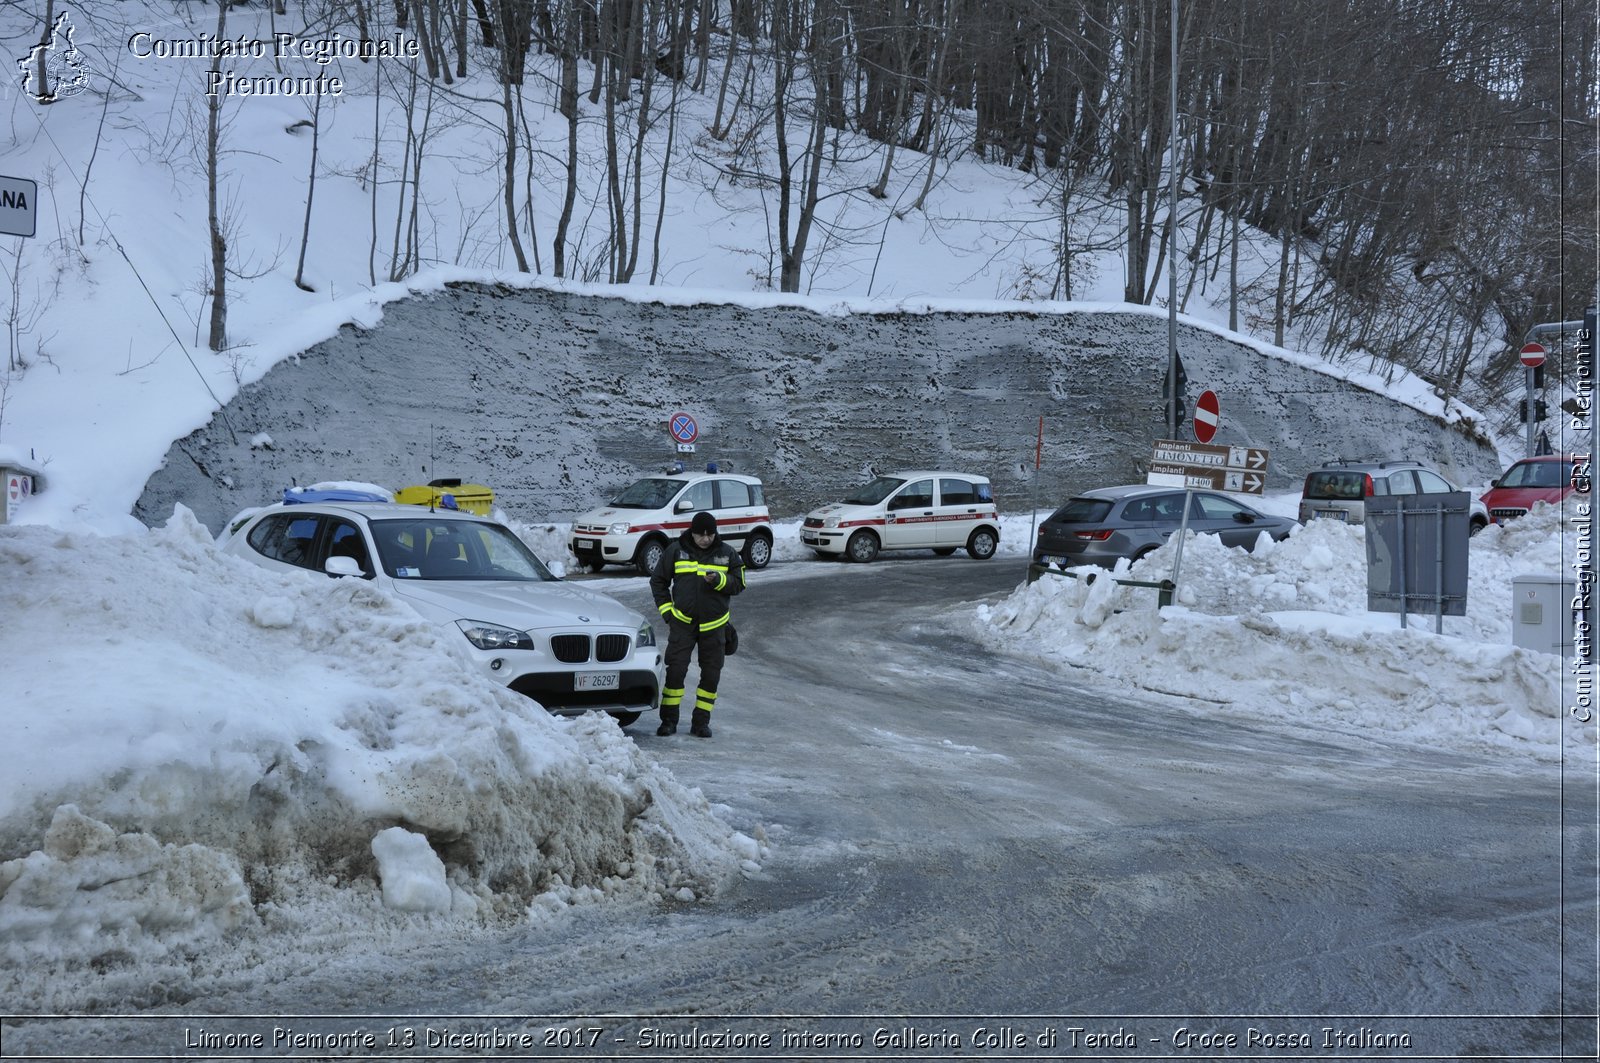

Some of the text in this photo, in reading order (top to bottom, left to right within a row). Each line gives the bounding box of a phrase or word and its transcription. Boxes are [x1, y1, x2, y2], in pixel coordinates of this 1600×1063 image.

[0, 189, 28, 210] NA
[1155, 450, 1224, 465] LIMONETTO
[578, 675, 616, 687] VF 26297
